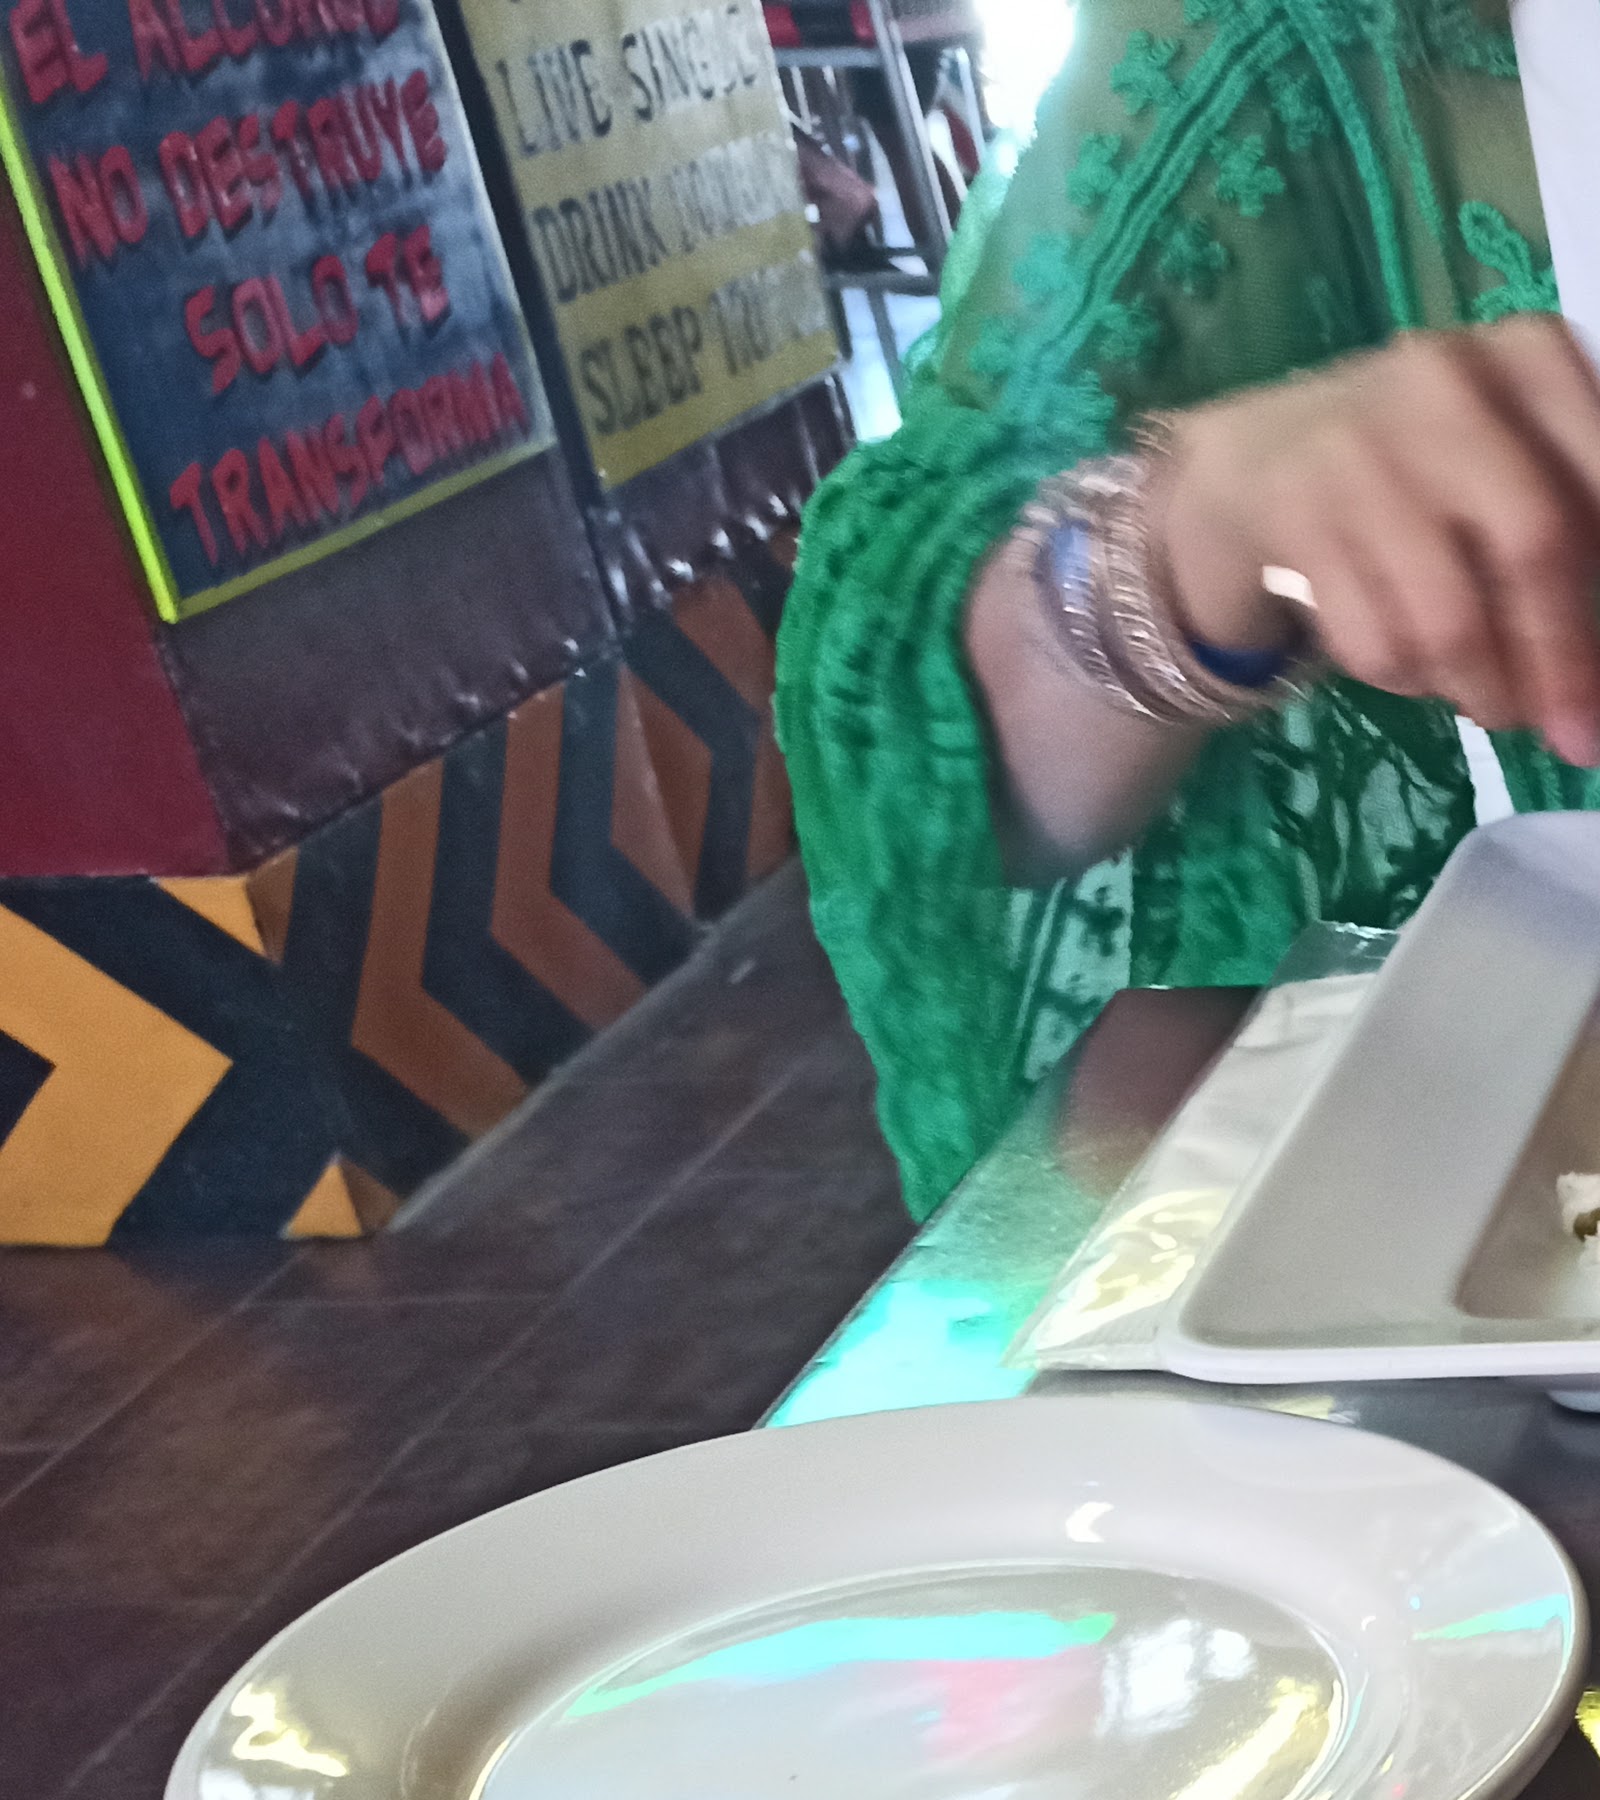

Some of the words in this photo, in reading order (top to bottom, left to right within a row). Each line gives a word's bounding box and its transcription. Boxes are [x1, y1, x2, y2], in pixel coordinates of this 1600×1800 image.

[11, 0, 108, 103] EL
[494, 38, 614, 158] LIVE
[48, 144, 148, 266] NO
[158, 70, 447, 238] DESTRUYE
[532, 177, 671, 303] DRINK
[184, 254, 360, 395] SOLO
[365, 223, 450, 328] TE
[169, 350, 533, 566] TRANSFORMA
